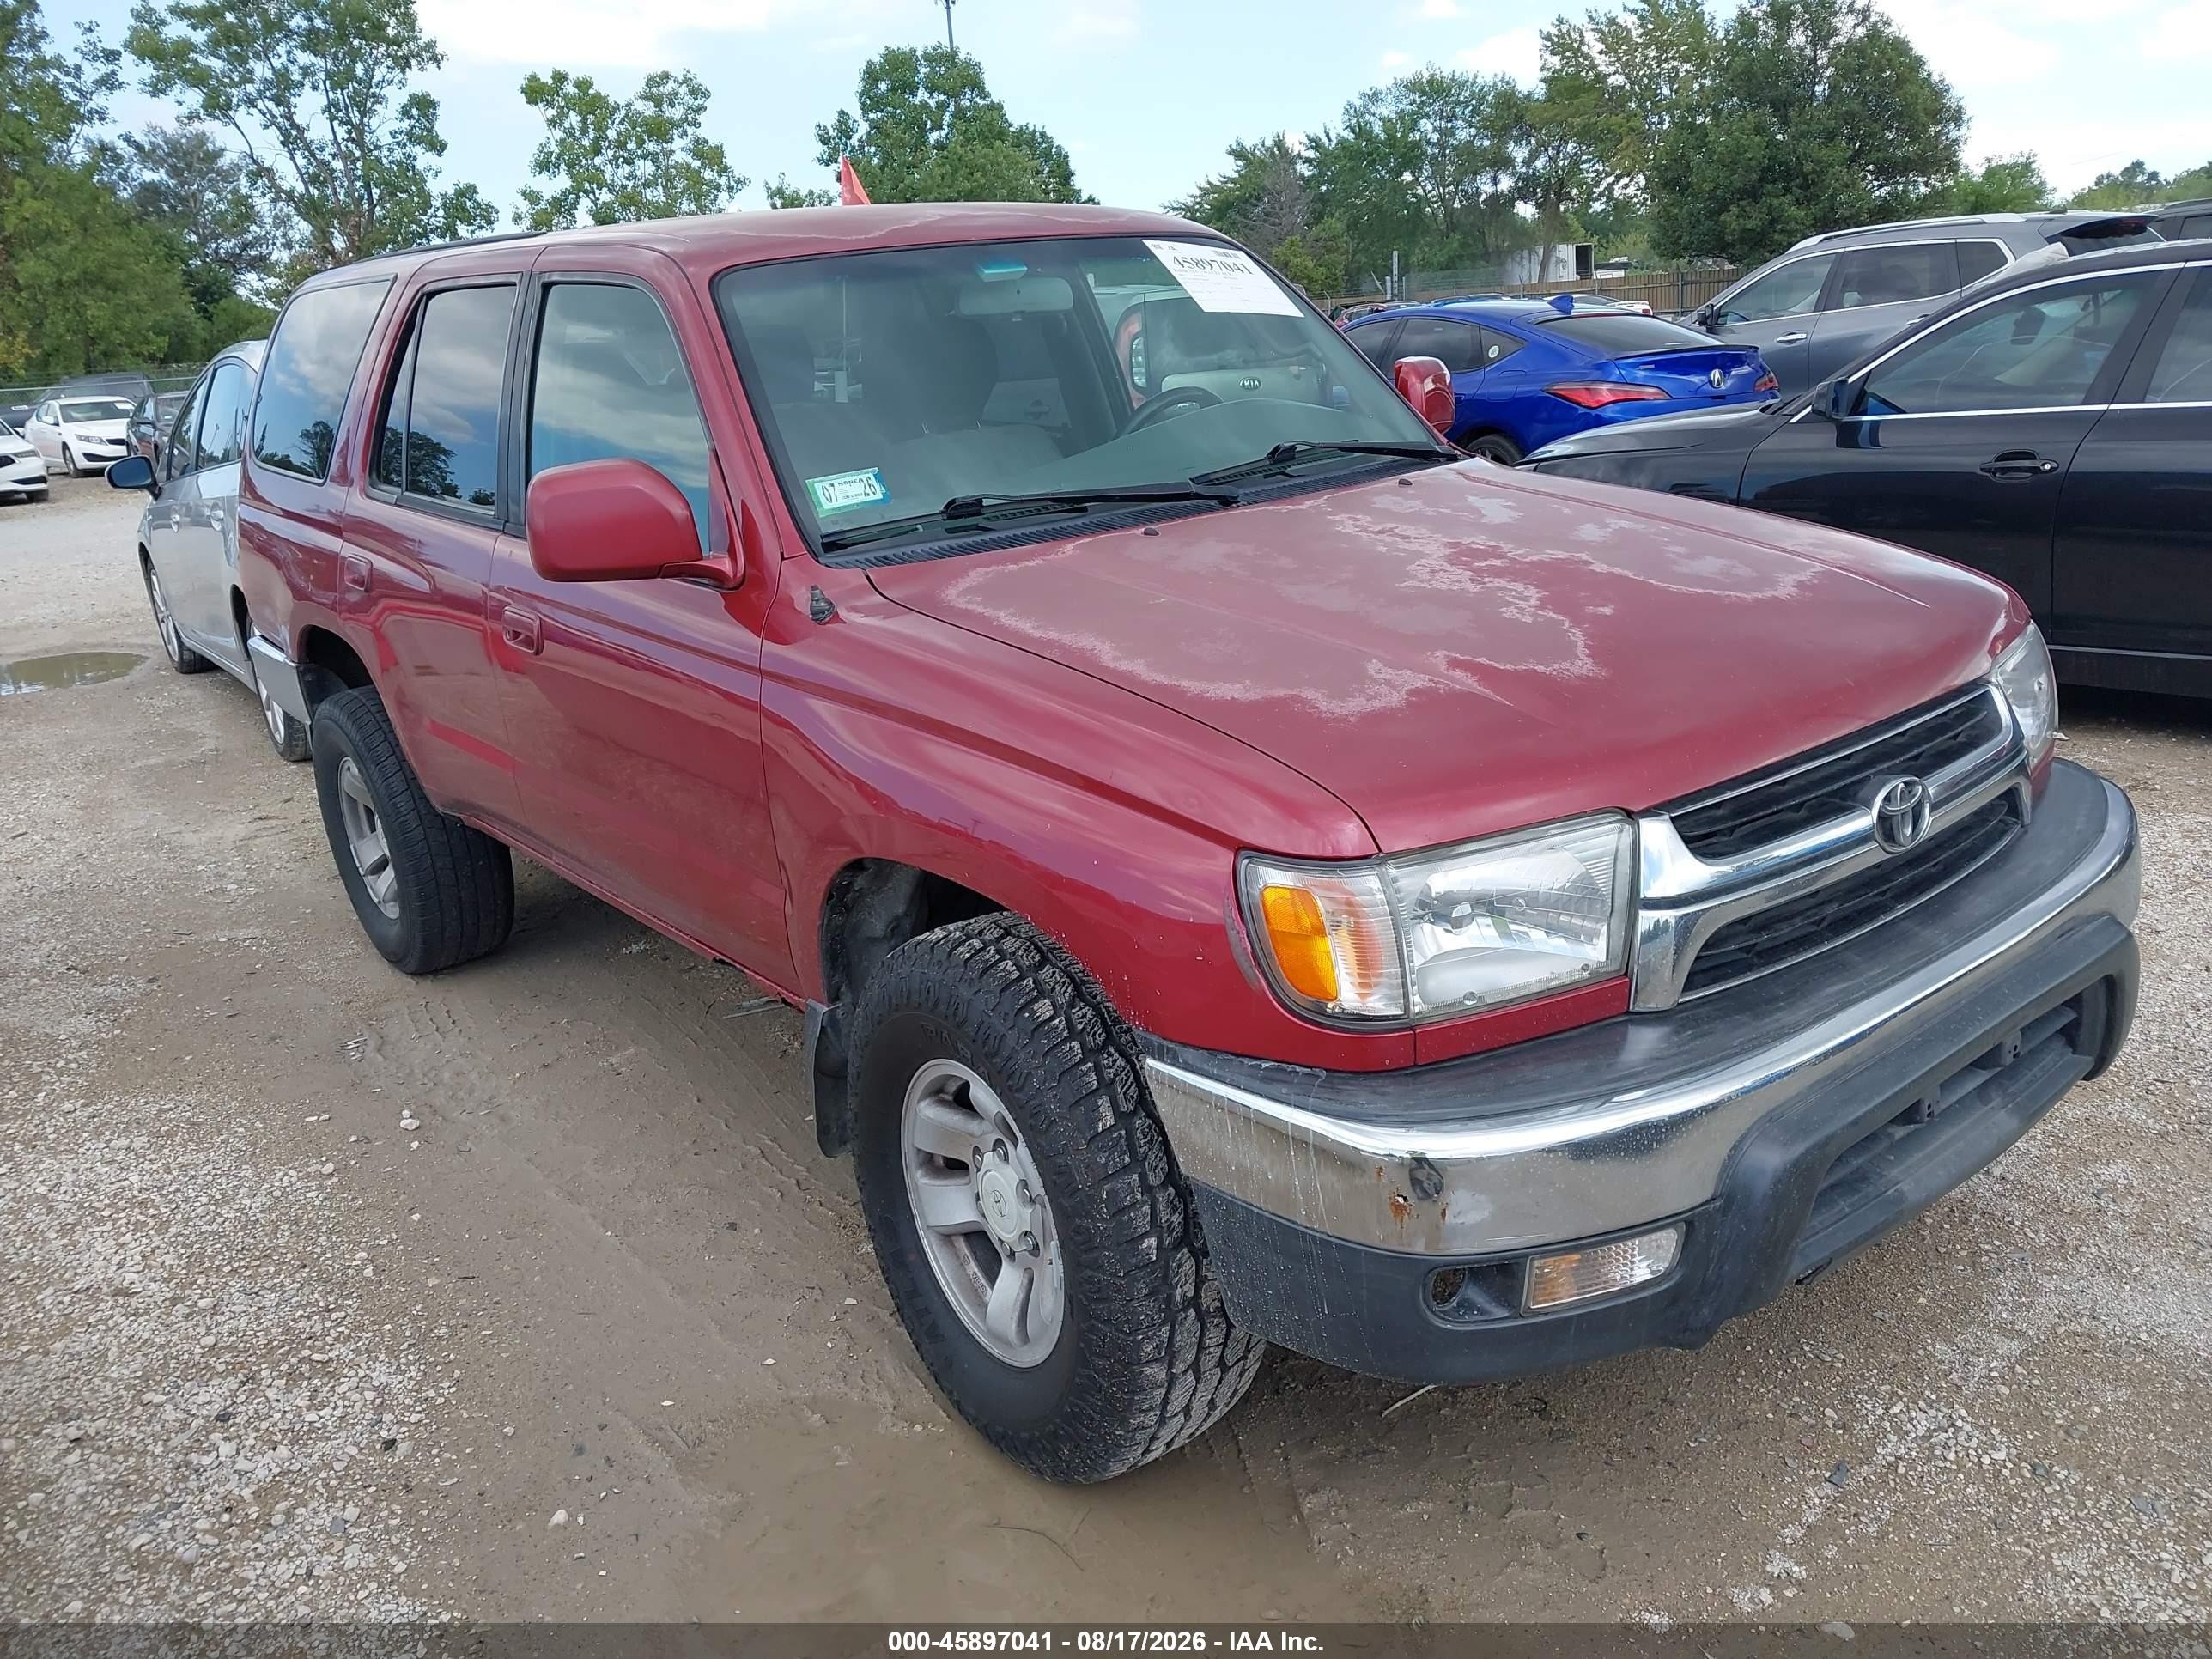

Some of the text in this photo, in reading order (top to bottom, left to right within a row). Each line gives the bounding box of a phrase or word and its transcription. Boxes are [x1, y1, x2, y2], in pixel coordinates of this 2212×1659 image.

[1173, 256, 1252, 275] 45897041
[1239, 379, 1261, 389] KIA
[821, 483, 838, 504] 07
[859, 476, 877, 498] 26
